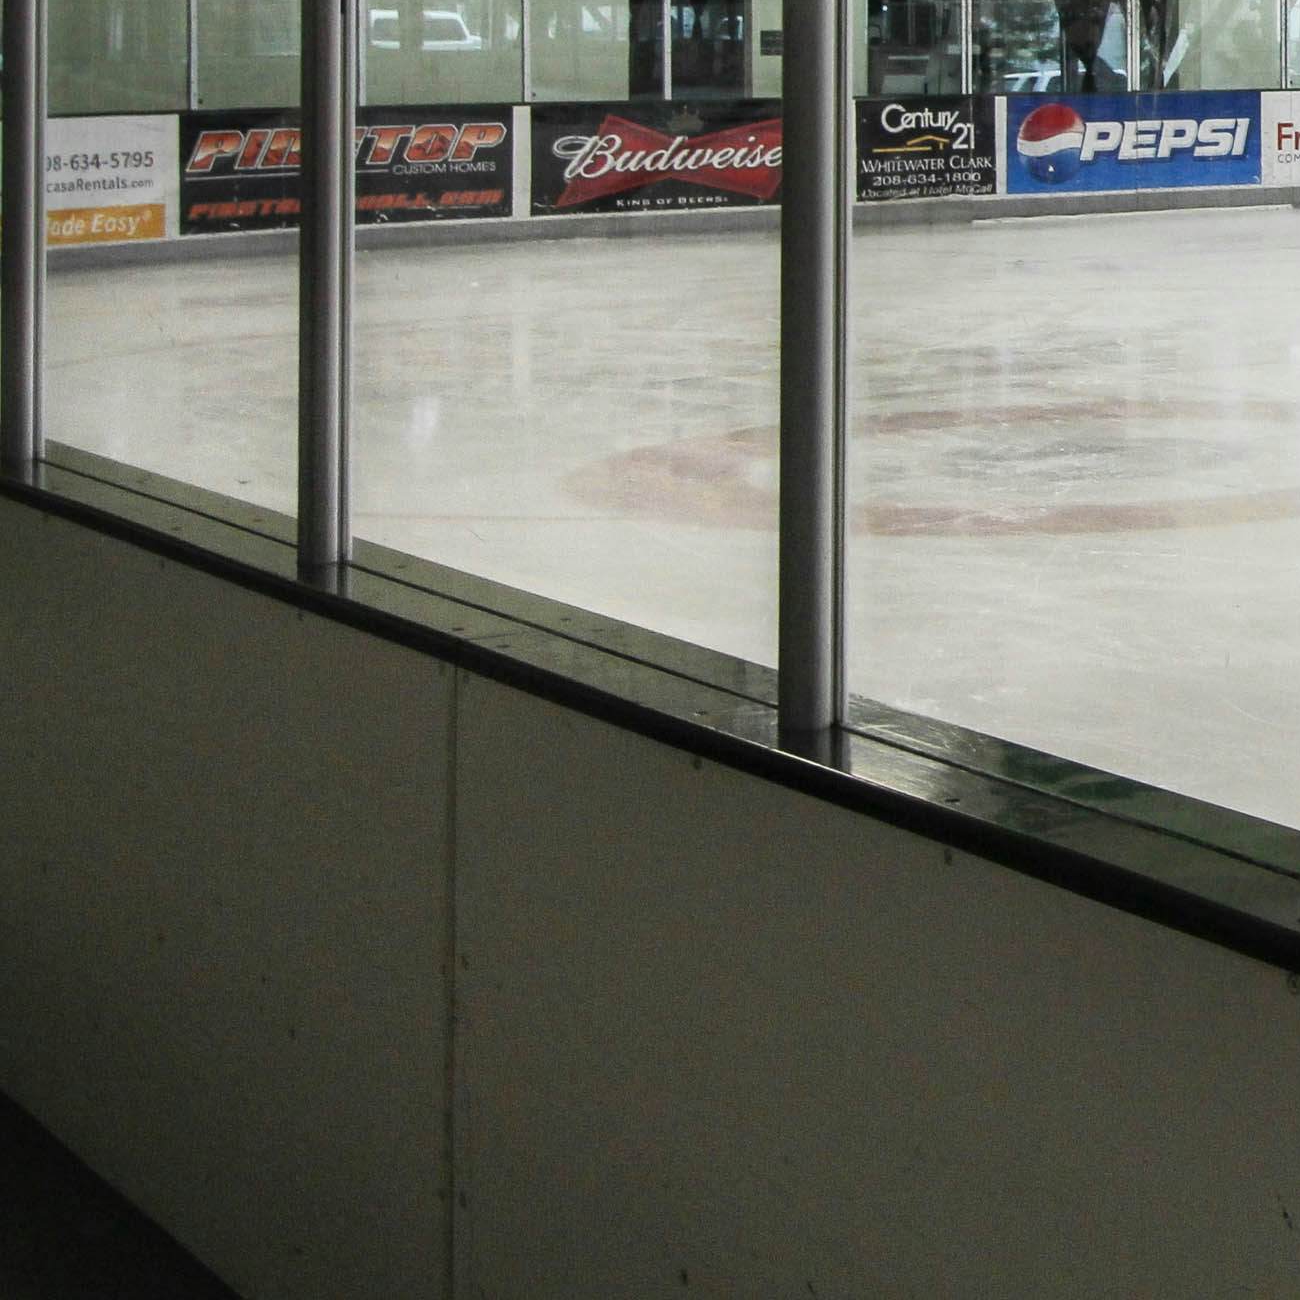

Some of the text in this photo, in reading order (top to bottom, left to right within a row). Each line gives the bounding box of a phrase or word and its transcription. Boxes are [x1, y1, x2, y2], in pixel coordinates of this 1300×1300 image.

[881, 103, 960, 133] Century
[951, 122, 976, 151] 21
[1079, 117, 1250, 161] PEPSI
[392, 161, 496, 176] CUSTOM HOMES
[552, 134, 782, 183] Budweise
[47, 177, 154, 194] casaRentals.com
[872, 172, 981, 187] 208-634-1800
[47, 214, 86, 237] ade
